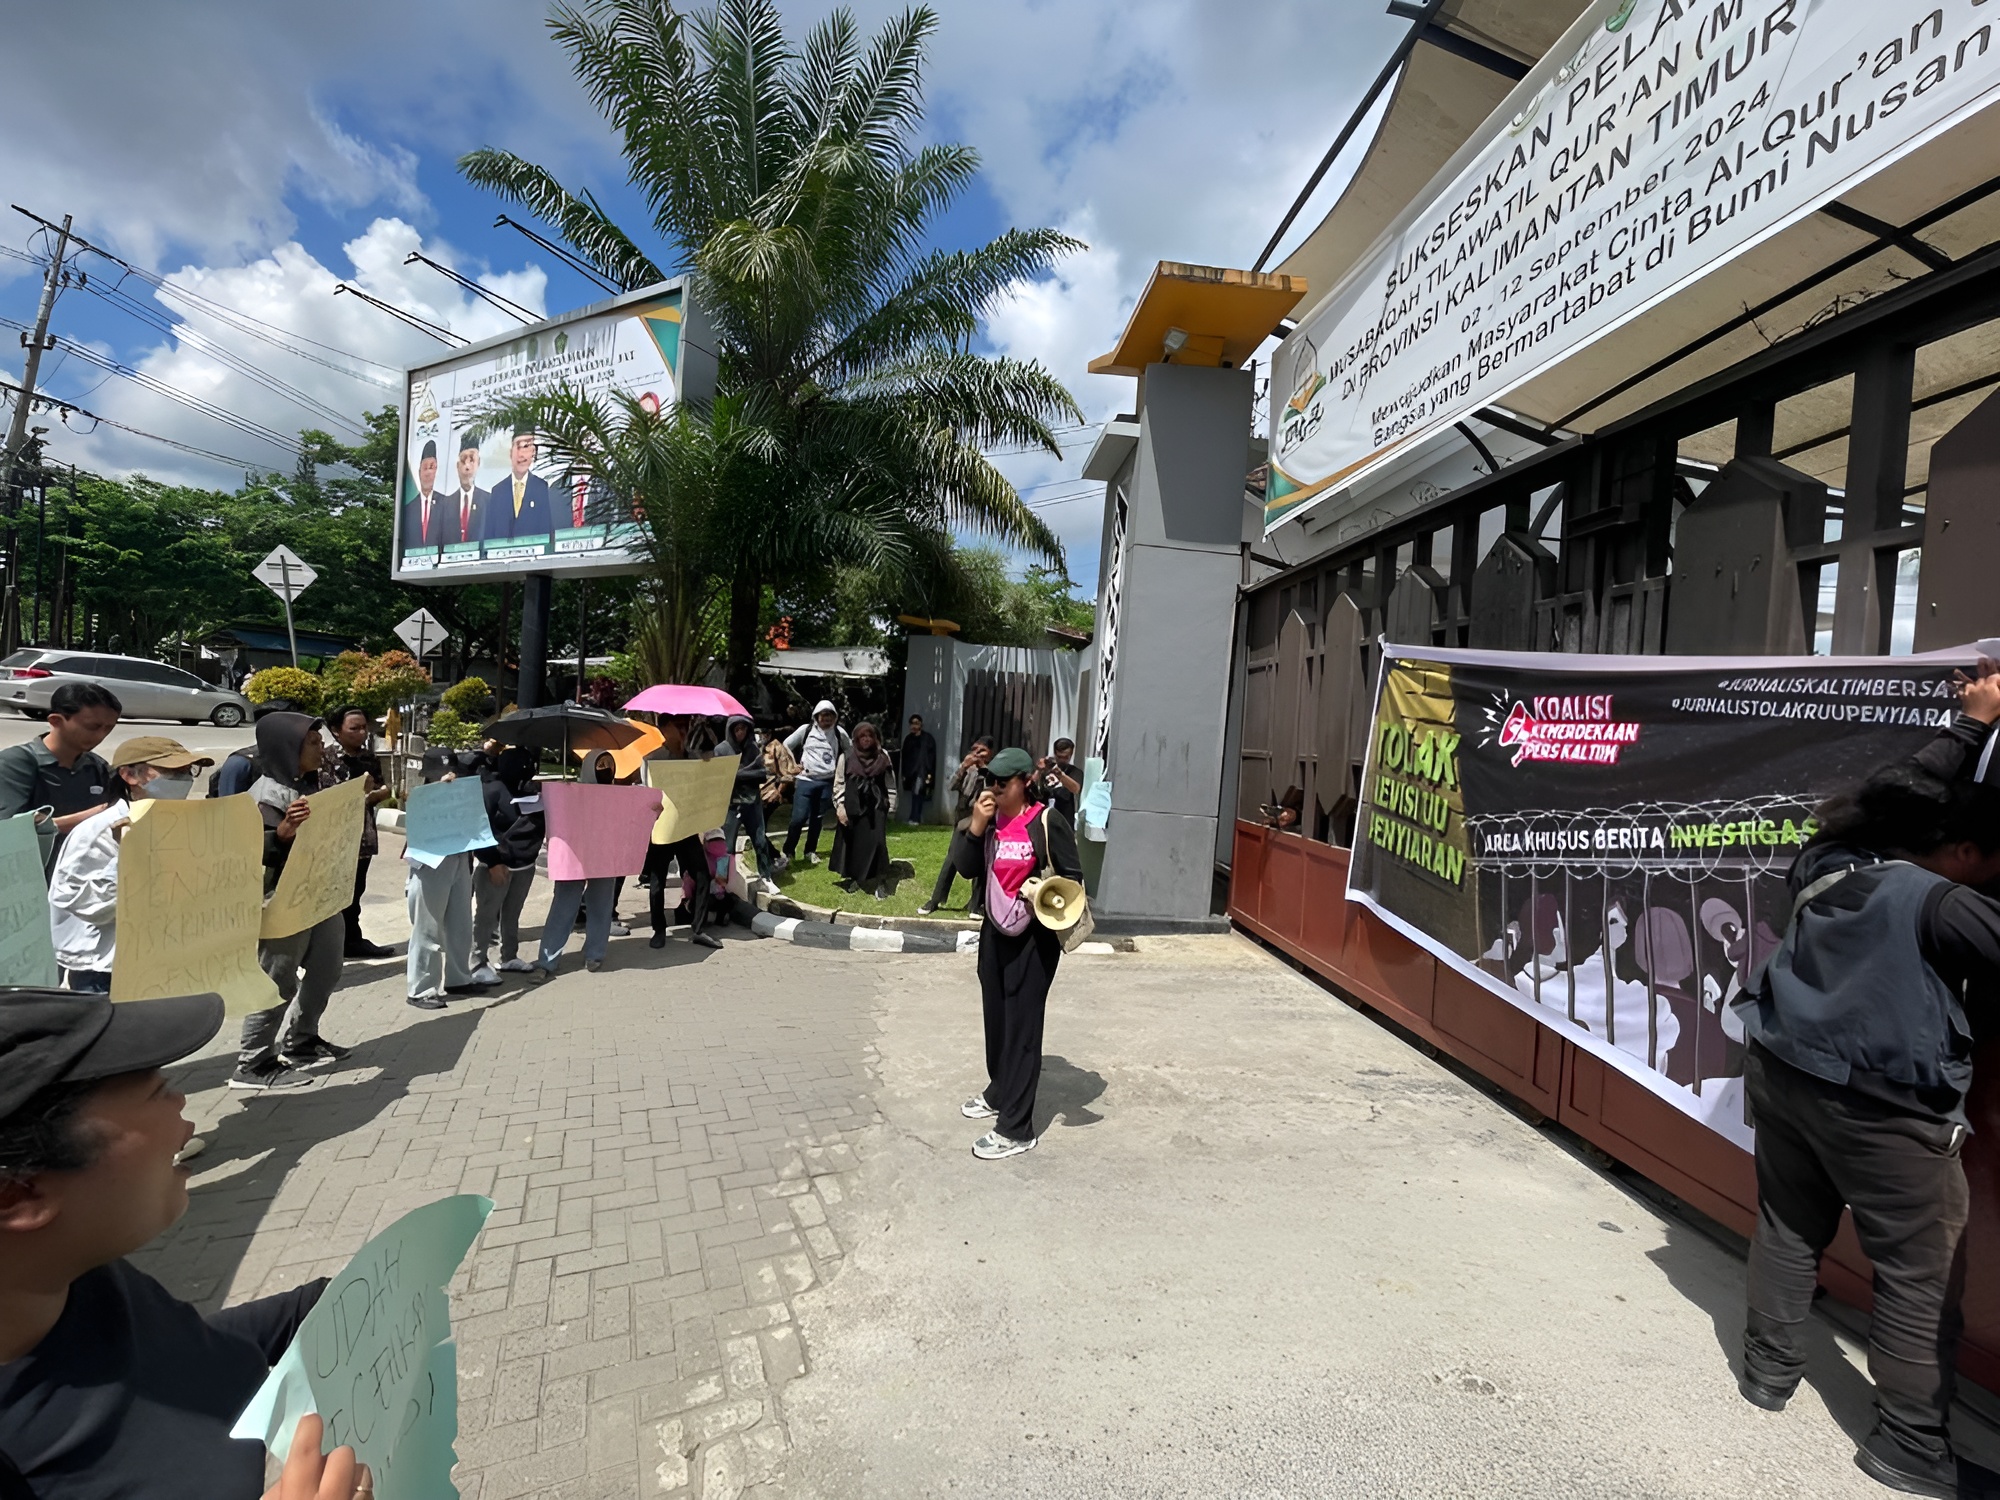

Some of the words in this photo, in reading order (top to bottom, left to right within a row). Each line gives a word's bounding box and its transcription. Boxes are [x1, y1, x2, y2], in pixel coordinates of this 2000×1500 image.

[1359, 300, 1440, 386] PROVINSI
[1445, 133, 1632, 315] KALIMANTAN
[1647, 0, 1798, 144] TIMUR
[1385, 112, 1553, 298] SUKSESKAN
[1566, 0, 1697, 126] PELA
[1426, 179, 1540, 293] TILAWATIL
[1461, 306, 1481, 333] 02
[1501, 274, 1523, 302] 12
[1684, 80, 1770, 166] 2024
[1477, 257, 1636, 381] Bermartabat
[1645, 228, 1675, 271] di
[1688, 150, 1790, 245] Bumi
[1806, 17, 2000, 169] Nusan
[1467, 249, 1600, 361] Masyarakat
[1608, 187, 1693, 260] Cinta
[1534, 694, 1614, 721] KOALISI
[1422, 791, 1449, 832] UU
[1594, 826, 1665, 850] BERITA
